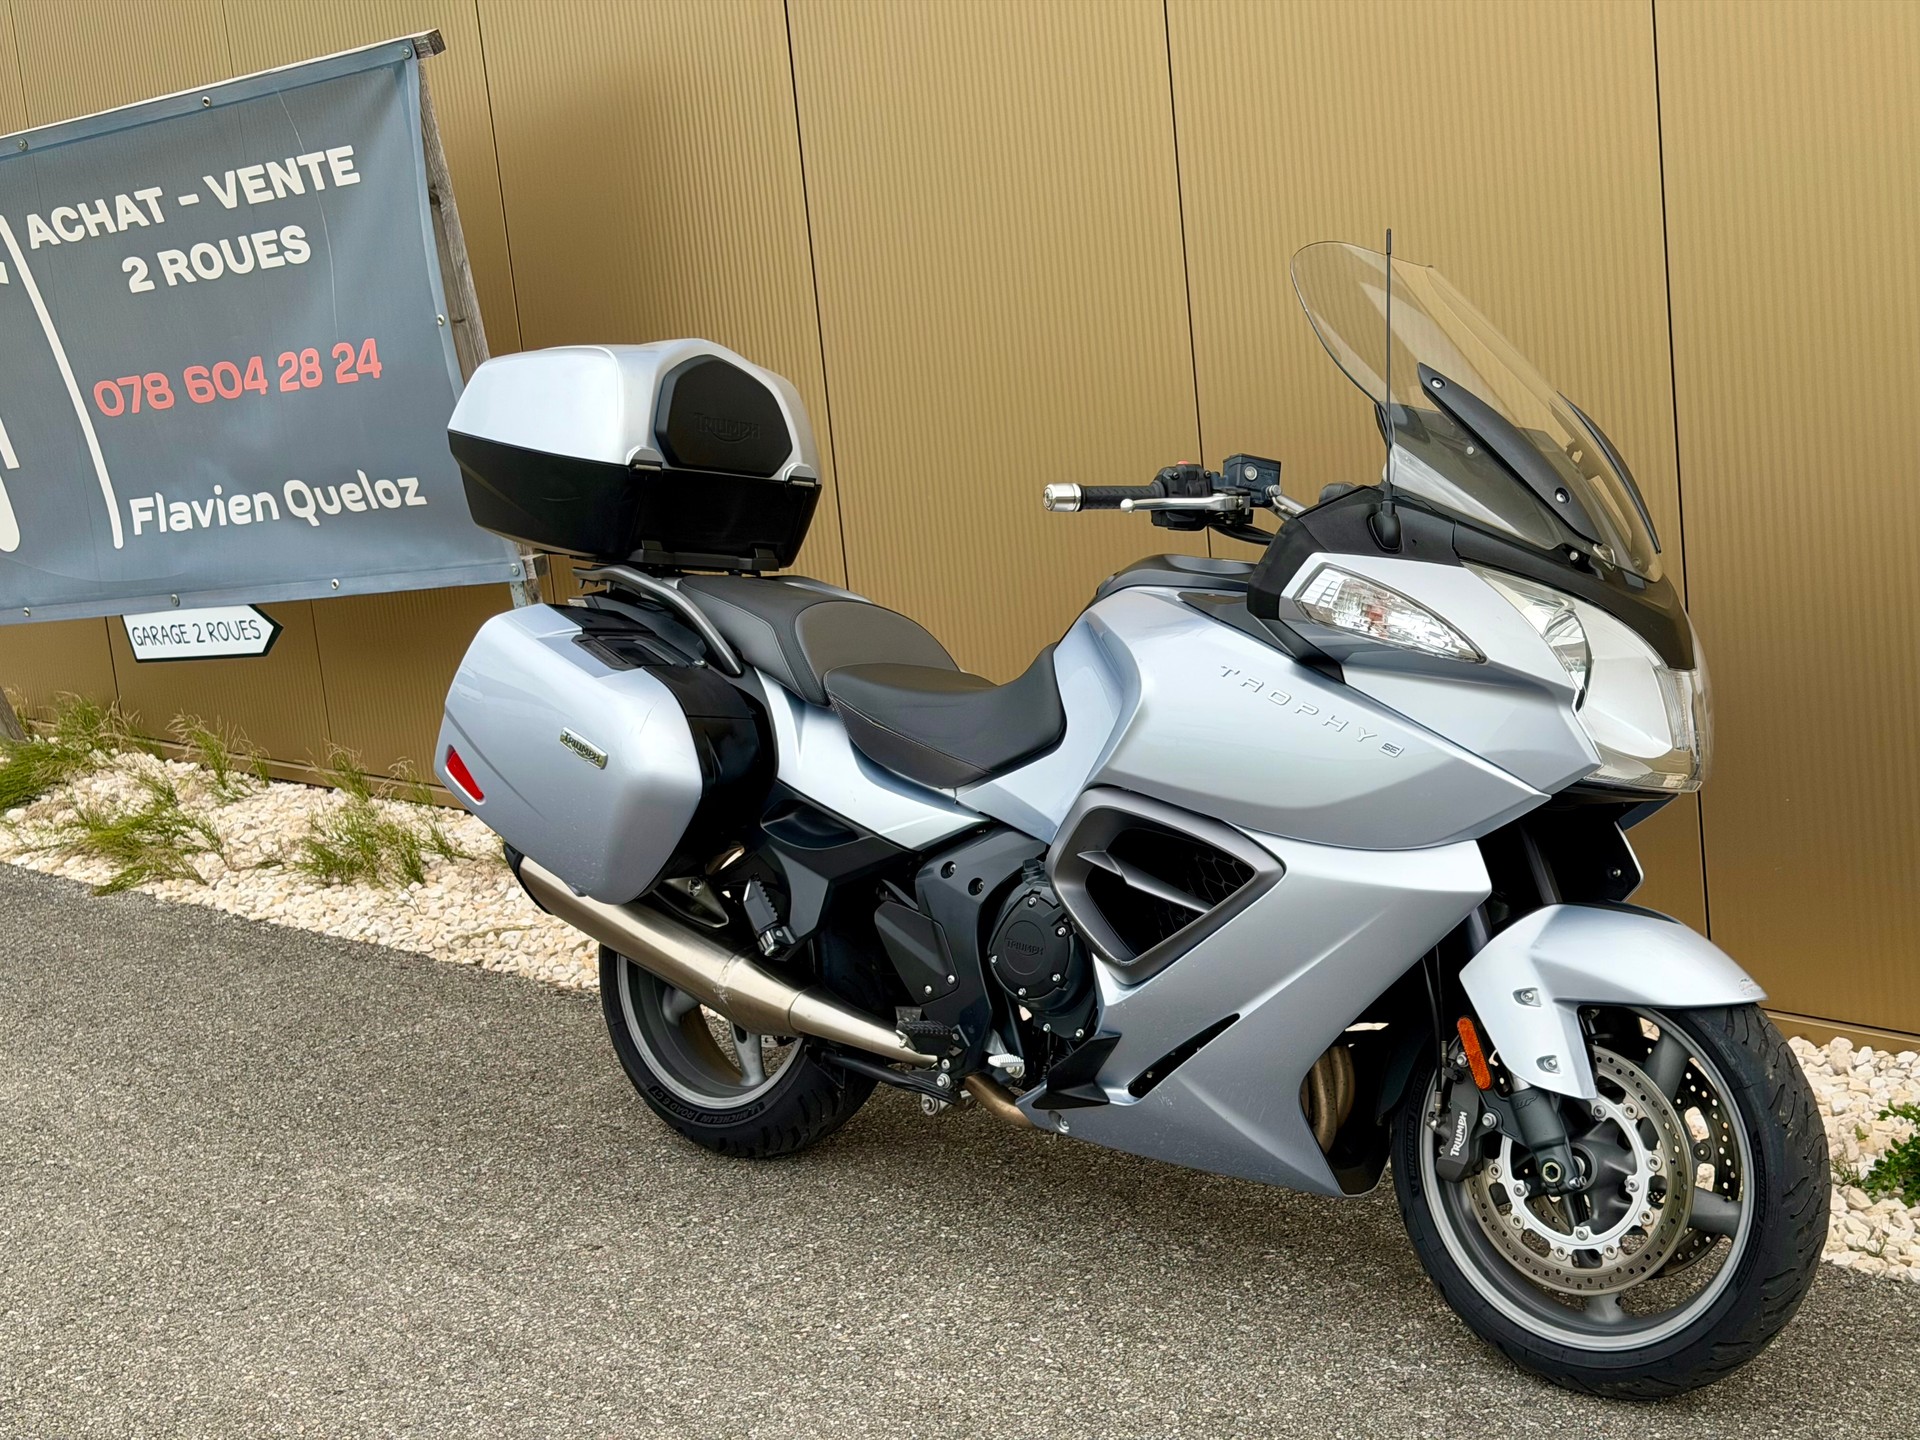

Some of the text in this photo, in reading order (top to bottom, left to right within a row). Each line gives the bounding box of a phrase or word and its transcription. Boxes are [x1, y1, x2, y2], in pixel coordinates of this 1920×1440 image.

[26, 186, 165, 250] ACHAT
[202, 144, 361, 209] VENTE
[121, 224, 311, 294] 2 ROUES
[93, 338, 382, 417] 078 604 28 24
[694, 412, 760, 442] TRIUMPH
[129, 469, 428, 536] Flavien Queloz
[131, 619, 262, 647] GARAGE 2 ROUES
[1220, 665, 1401, 755] TROPHY SE
[563, 731, 602, 764] TRIUMPH
[1005, 938, 1044, 956] TRIUMPH
[669, 1103, 695, 1119] ROAD
[1450, 1111, 1468, 1157] TRIUMPH
